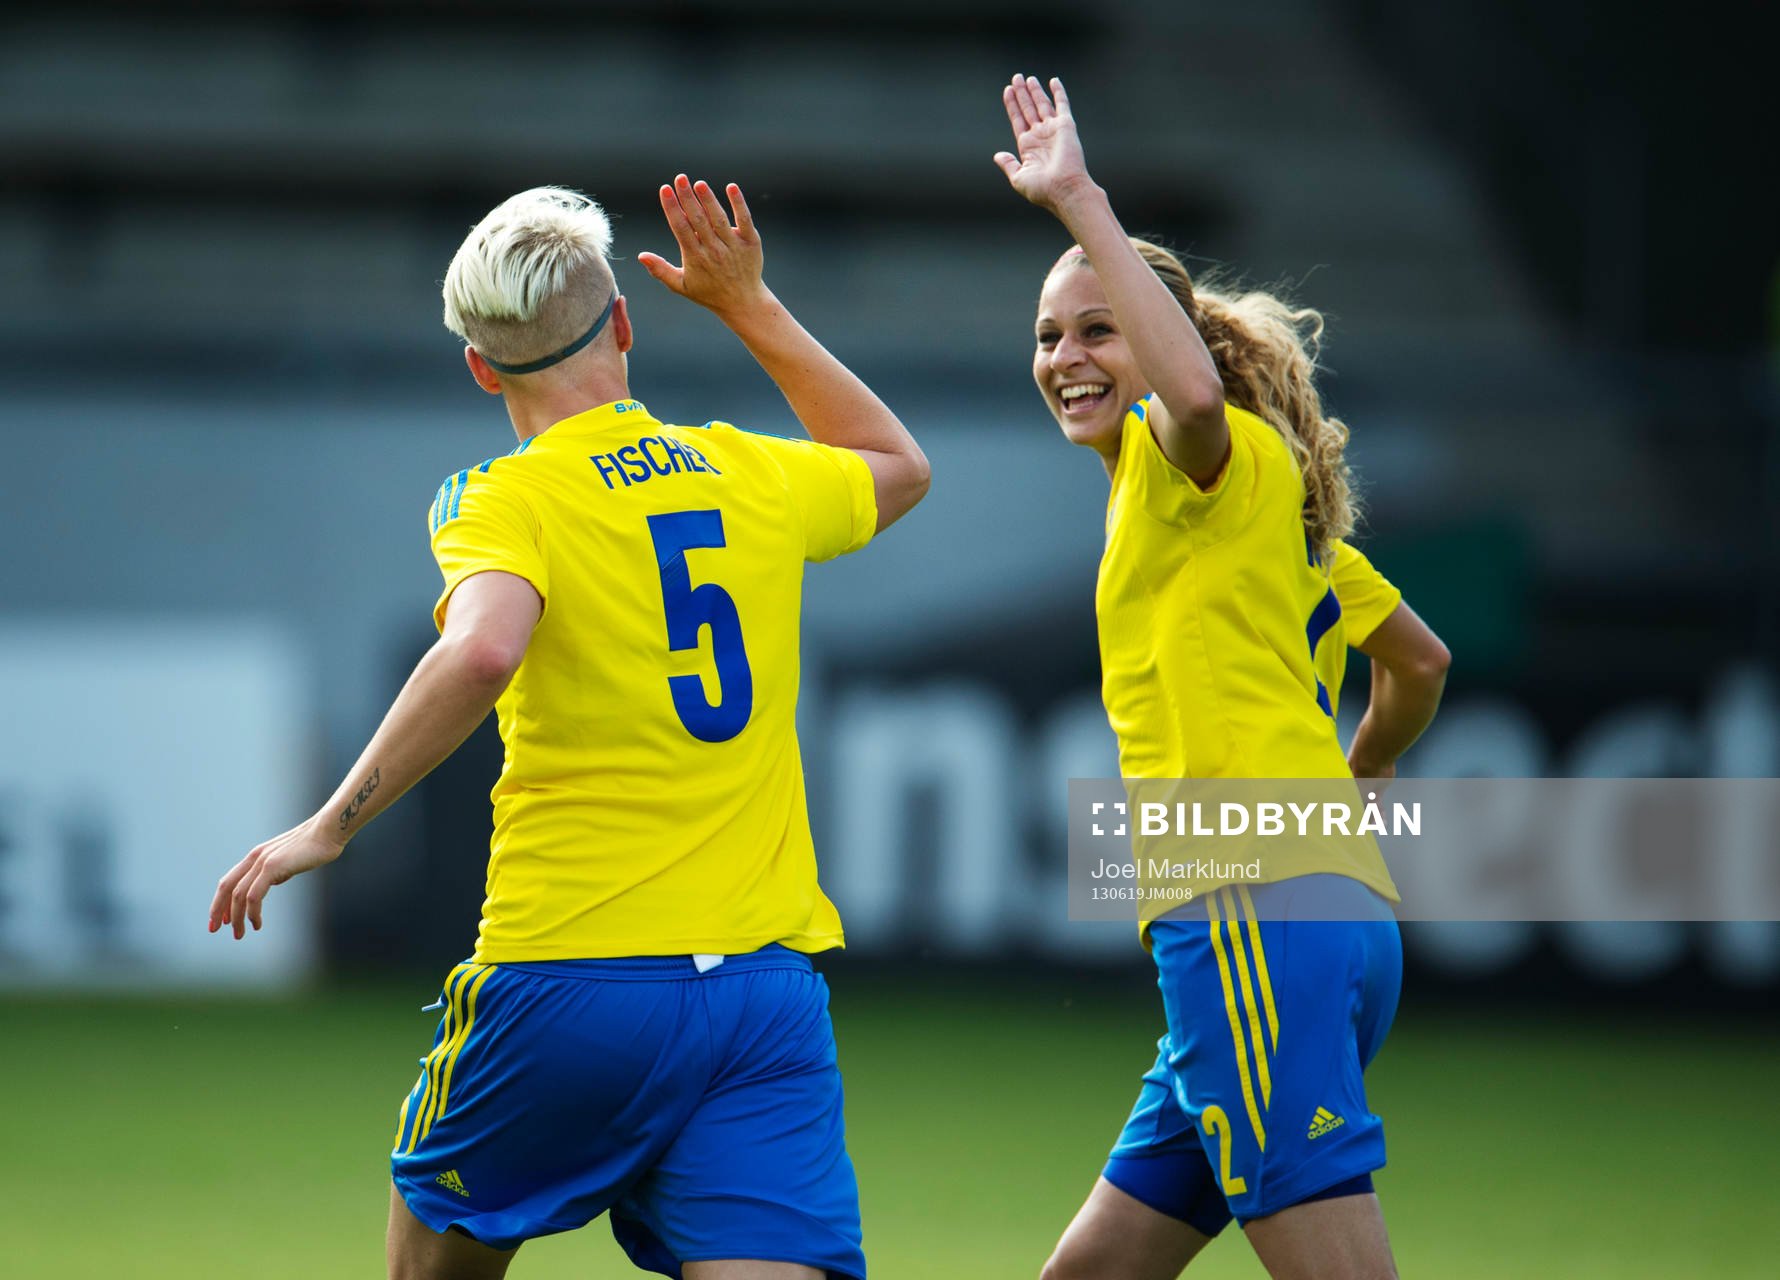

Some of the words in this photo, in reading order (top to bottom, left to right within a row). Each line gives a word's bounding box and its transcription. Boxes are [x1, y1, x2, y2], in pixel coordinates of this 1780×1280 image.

[589, 435, 722, 490] FISCHER
[646, 508, 753, 743] 5
[1201, 1104, 1248, 1197] 2
[1307, 1115, 1345, 1141] adidas
[435, 1176, 470, 1198] adidas
